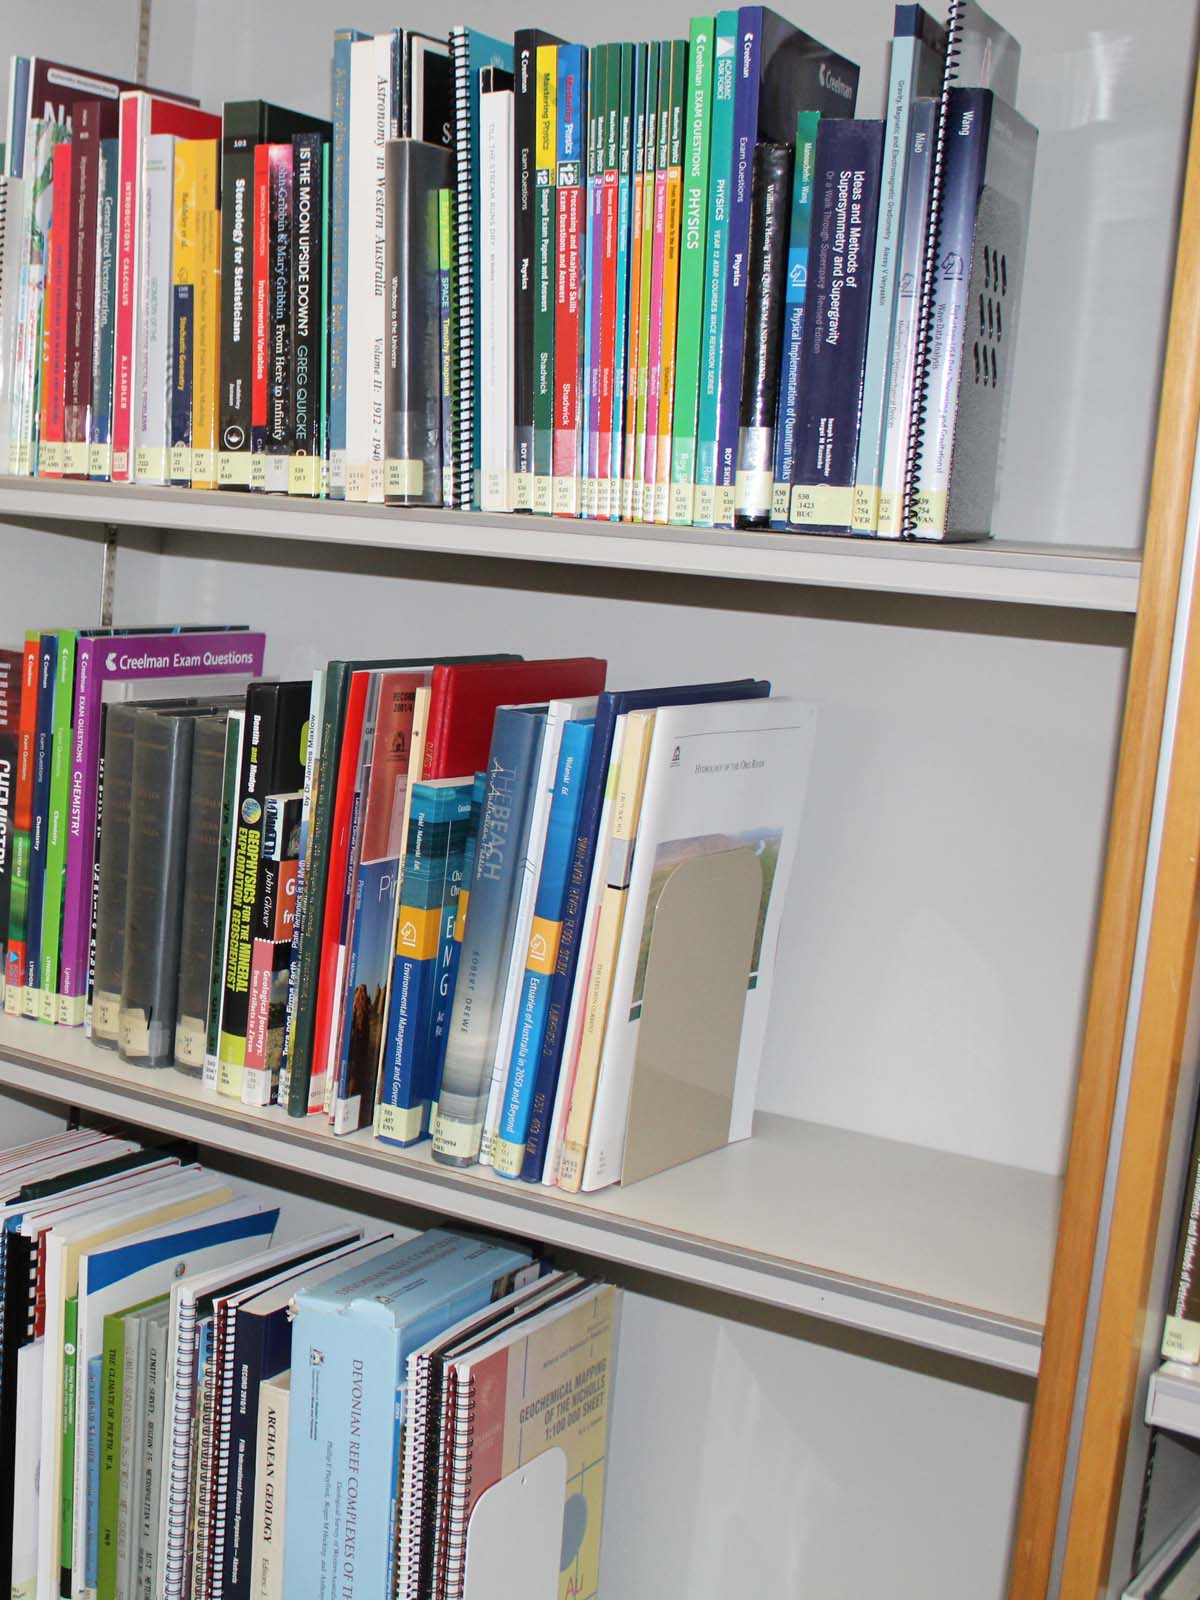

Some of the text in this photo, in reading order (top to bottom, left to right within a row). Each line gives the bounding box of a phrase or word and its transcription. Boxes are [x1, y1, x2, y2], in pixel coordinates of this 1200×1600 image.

[687, 44, 705, 249] Creelman EXAM QUESTIONS PHYSICS
[913, 132, 926, 153] Miao
[957, 110, 974, 136] Wang
[374, 76, 389, 297] Astronomy in Western Australia
[538, 170, 549, 185] 12
[560, 163, 575, 187] 12
[714, 179, 725, 221] PHYSICS
[122, 181, 132, 306] INTRODUCTORY CALCULUS
[277, 190, 288, 231] Gribbin
[277, 233, 287, 244] &
[297, 148, 311, 337] IS THE MOON UPSIDE DOWN?
[845, 170, 866, 288] Ideas and Methods of
[232, 178, 247, 342] Stereology for Statisticians
[274, 246, 286, 272] Mary
[558, 190, 568, 304] Exam Questions and Answers
[567, 189, 579, 314] Processing and Analytical Skills
[724, 42, 752, 465] Creelman Exam Questions Physics ROY
[826, 170, 852, 345] Supersymmetry and Supergravity
[275, 276, 287, 320] Gribbin
[390, 276, 399, 369] Window to the Universe
[441, 277, 449, 308] SPACE
[373, 338, 384, 376] Volume
[930, 303, 947, 370] Wave Data Analysis
[272, 324, 286, 441] From Here to Infinity
[295, 344, 308, 440] GREG QUICKE
[540, 352, 550, 395] Shadwick
[562, 383, 572, 426] Shadwick
[782, 307, 804, 481] Physical Implementation of Quantum Walks
[372, 402, 383, 426] 1912
[371, 438, 382, 462] 1940
[119, 650, 253, 671] Creelman Exam Questions
[70, 660, 90, 837] Creelman EXAM QUESTIONS CHEMISTRY
[246, 714, 262, 793] Dentith and Mudge
[483, 803, 512, 881] BEACH
[225, 827, 249, 993] EXPLORATION GEOSCIENTIST
[235, 829, 261, 993] GEOPHYSICS FOR THE MINERAL
[261, 868, 276, 928] John Glover
[254, 970, 272, 1057] Geological Journeys:
[399, 962, 413, 1016] Environmental
[461, 951, 482, 1033] ROBERT DREWE
[392, 1016, 408, 1065] Management
[394, 1066, 403, 1081] and
[504, 977, 540, 1134] Estuaries of Australia in 2050 and Beyond
[1182, 1235, 1196, 1271] Methods
[1187, 1219, 1198, 1235] and
[1180, 1271, 1192, 1282] of
[519, 1357, 607, 1425] GEOCHEMICAL MAPPING
[544, 1374, 606, 1425] OF THE NICHOLLS
[544, 1392, 605, 1440] 1:100 000 SHEET
[262, 1406, 278, 1545] ARCHAEAN GEOLOGY
[343, 1359, 365, 1583] DEVONIAN REEF COMPLEXES OF
